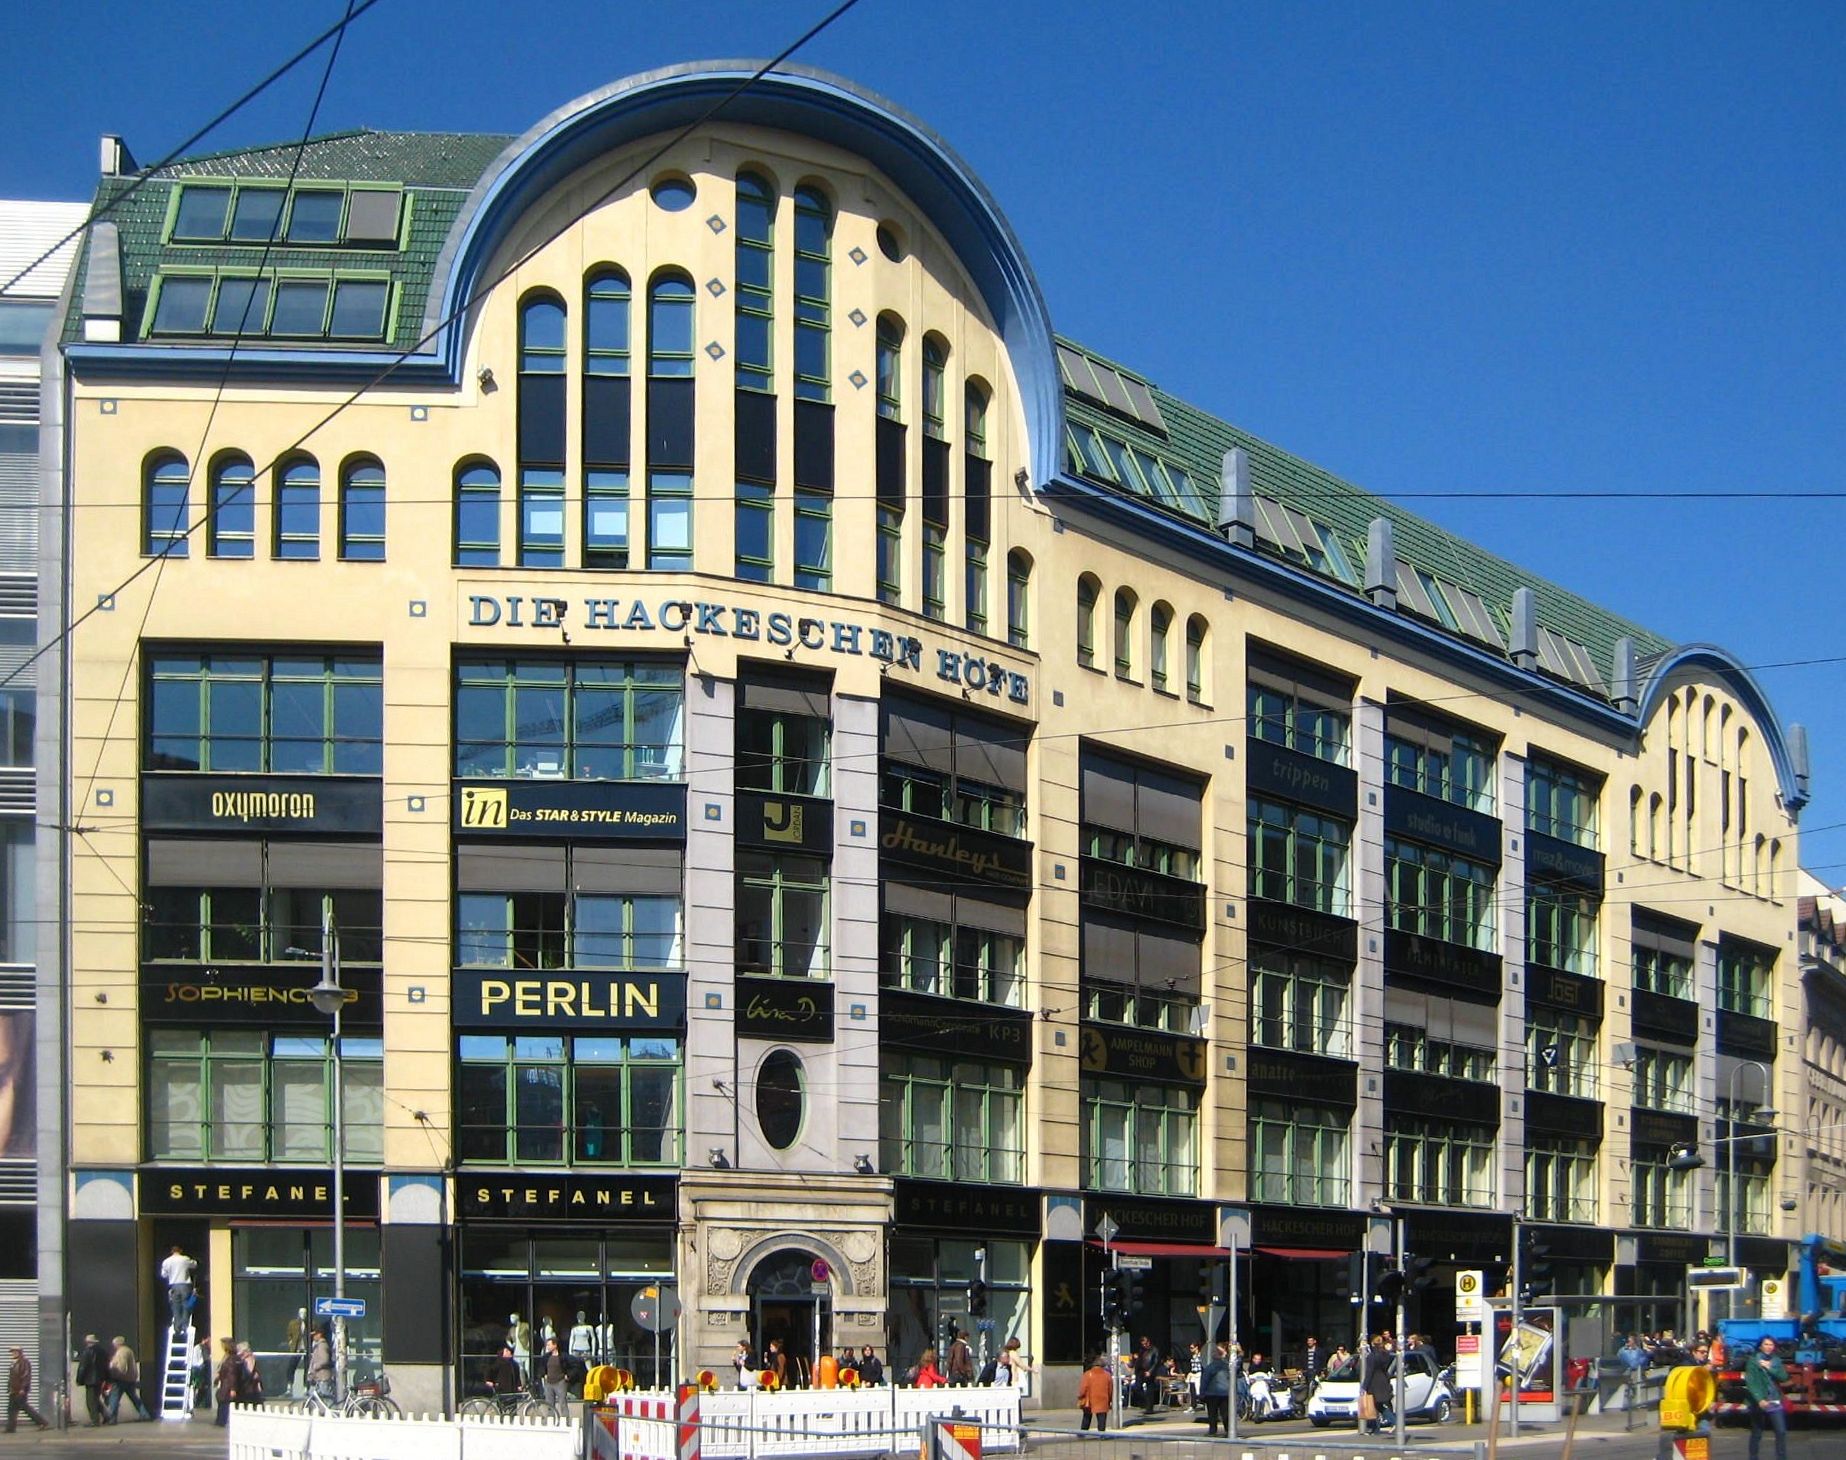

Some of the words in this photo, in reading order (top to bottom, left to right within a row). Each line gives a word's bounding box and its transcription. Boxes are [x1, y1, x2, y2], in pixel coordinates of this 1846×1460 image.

[469, 595, 561, 627] DIE
[584, 599, 921, 673] HACKESCHEN
[936, 650, 1028, 705] HÖFE
[1273, 758, 1330, 792] trippen
[212, 792, 314, 822] oxymoron
[464, 791, 504, 825] in
[510, 808, 532, 821] Das
[624, 810, 677, 826] Magazin
[164, 983, 359, 1004] SOPHIENCB
[481, 980, 658, 1018] PERLIN
[1128, 1054, 1157, 1069] SHOP
[169, 1184, 350, 1200] STEFANE
[477, 1188, 656, 1205] STEFANEL
[911, 1197, 1029, 1217] STEFANEL
